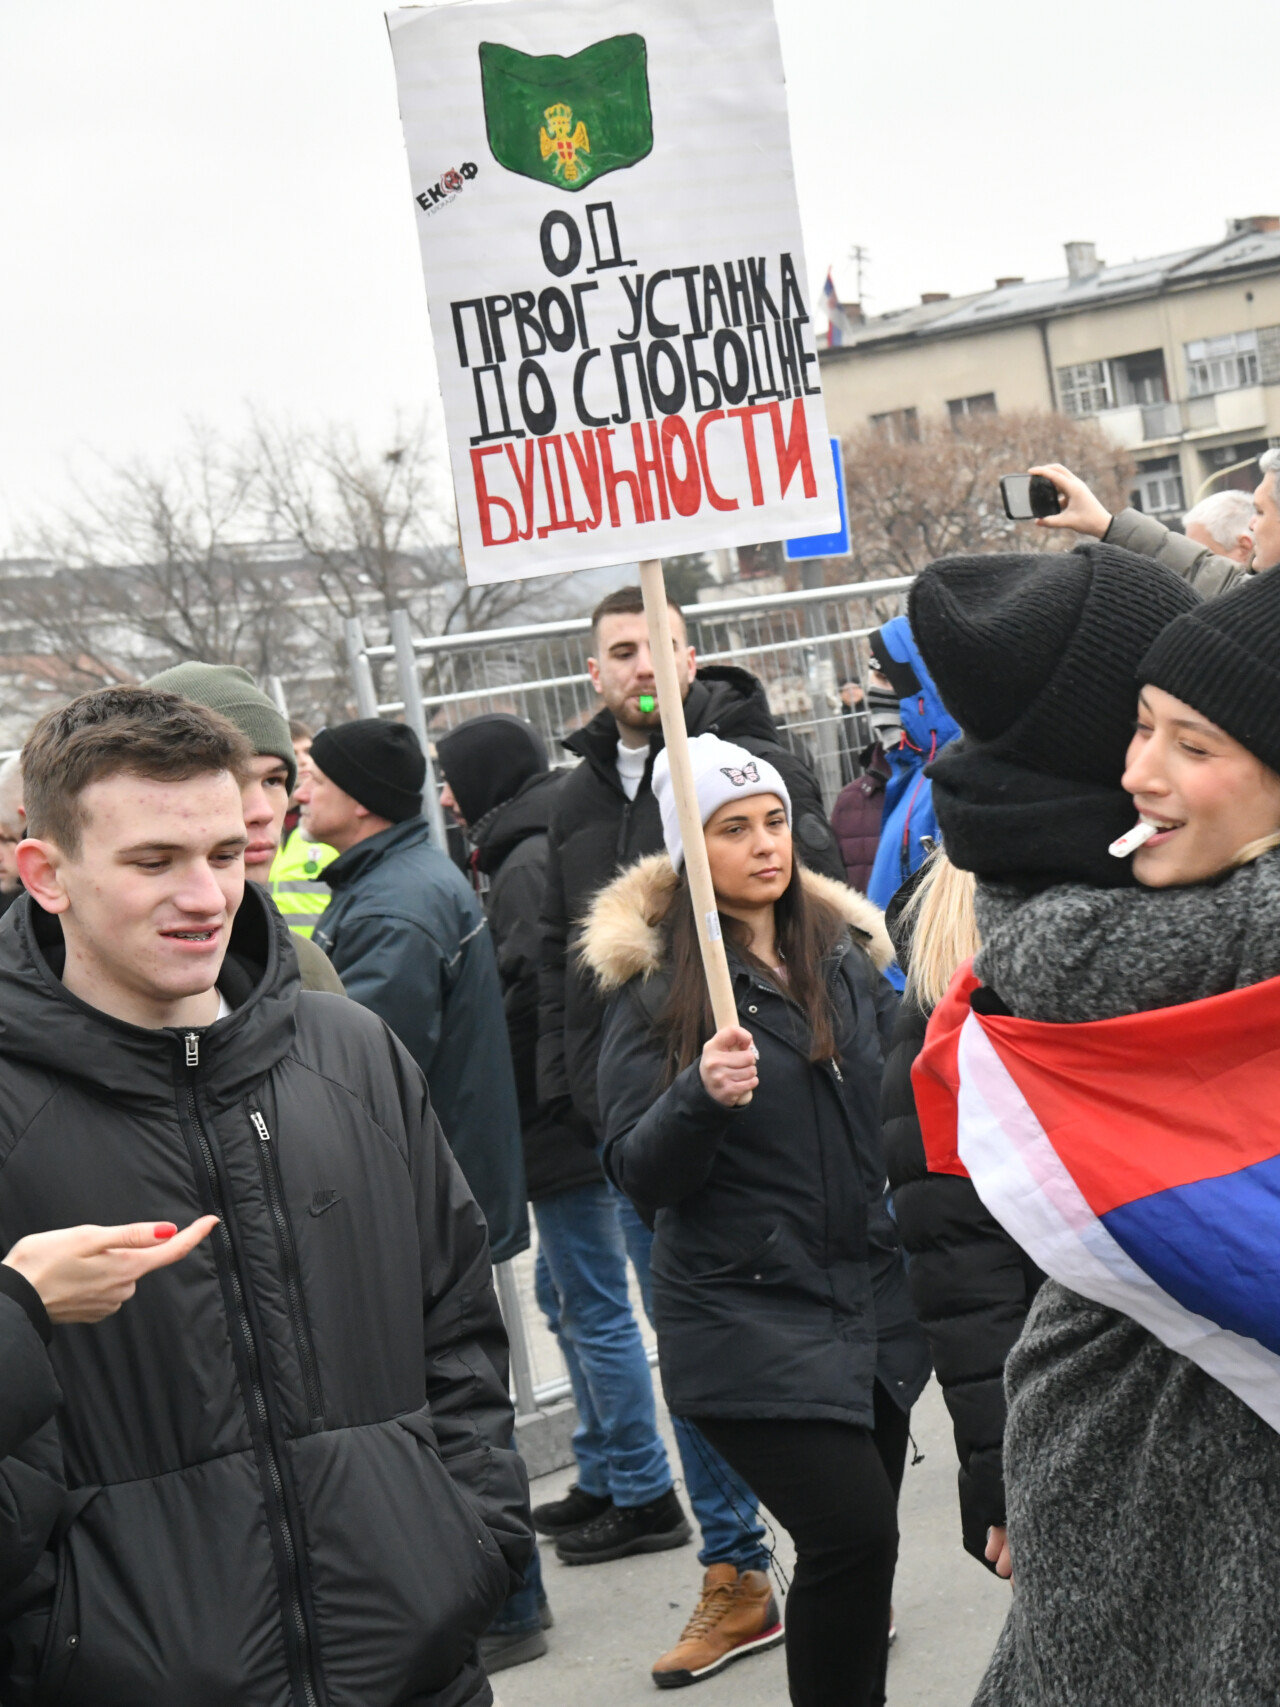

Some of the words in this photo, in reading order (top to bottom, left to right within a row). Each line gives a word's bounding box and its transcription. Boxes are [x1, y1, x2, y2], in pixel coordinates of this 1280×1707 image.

[415, 161, 479, 212] ЕКФ
[539, 201, 638, 277] ОД
[450, 280, 599, 368] ПРВОГ
[617, 252, 807, 341] УСТАНКА
[469, 358, 558, 446] ДО
[573, 315, 821, 427] СЛОБОДНЕ
[469, 397, 818, 547] БУДУЋНОСТИ
